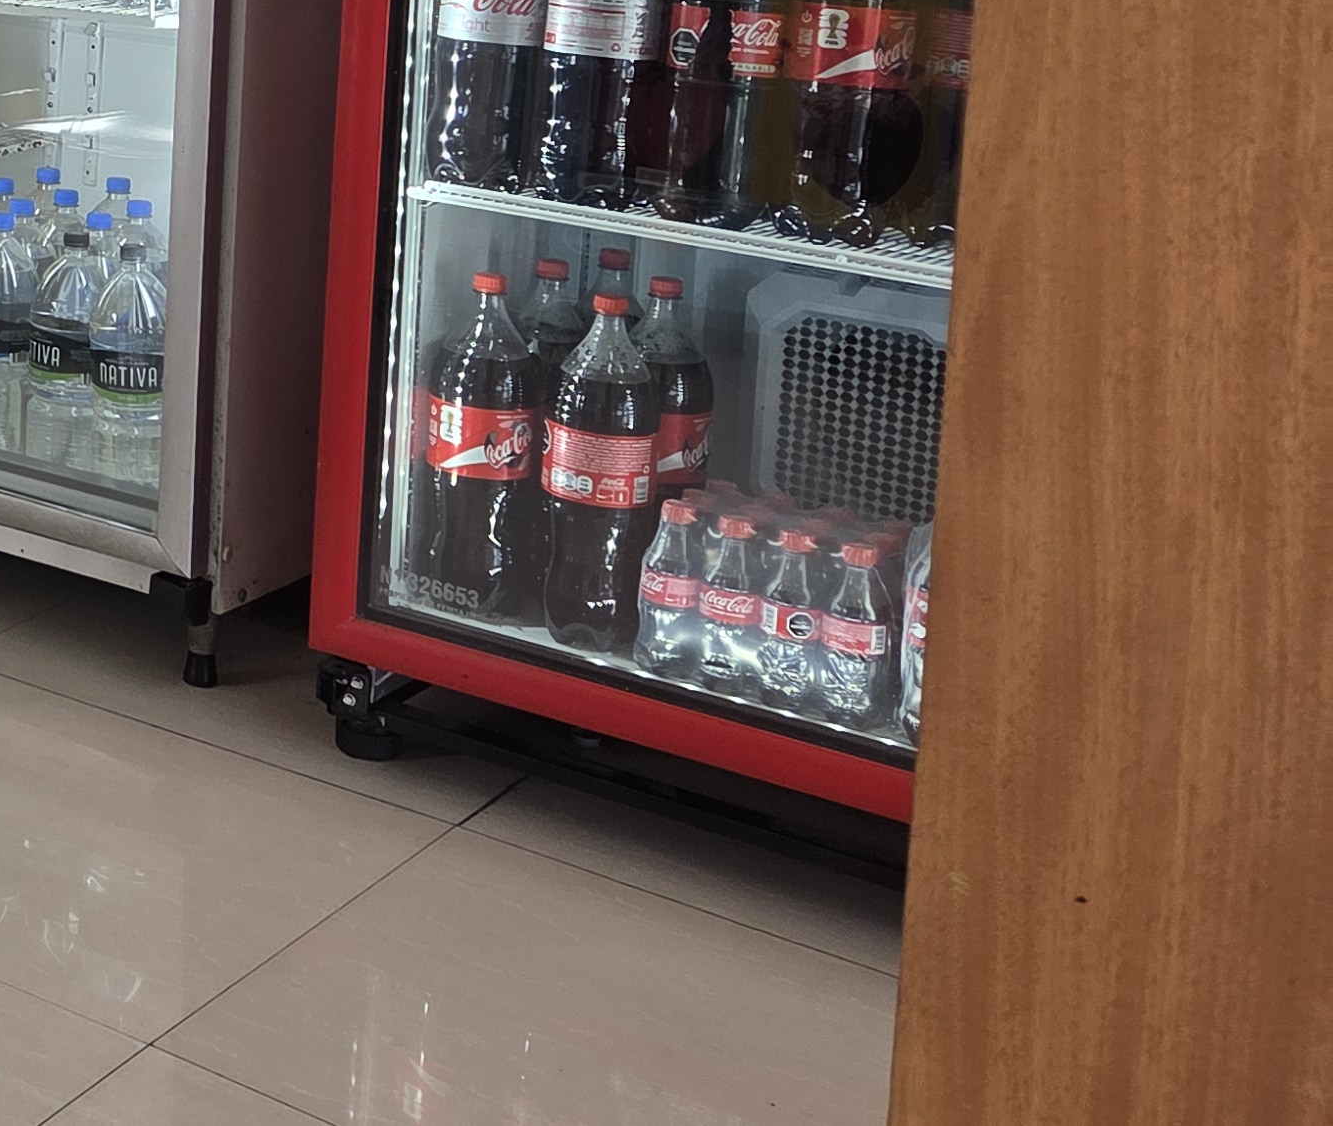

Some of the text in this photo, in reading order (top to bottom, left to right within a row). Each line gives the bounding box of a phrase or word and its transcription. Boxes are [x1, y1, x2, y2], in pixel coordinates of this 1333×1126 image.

[29, 340, 61, 368] TIVA
[99, 361, 158, 389] NATIVA
[703, 589, 754, 615] Coca-Cola
